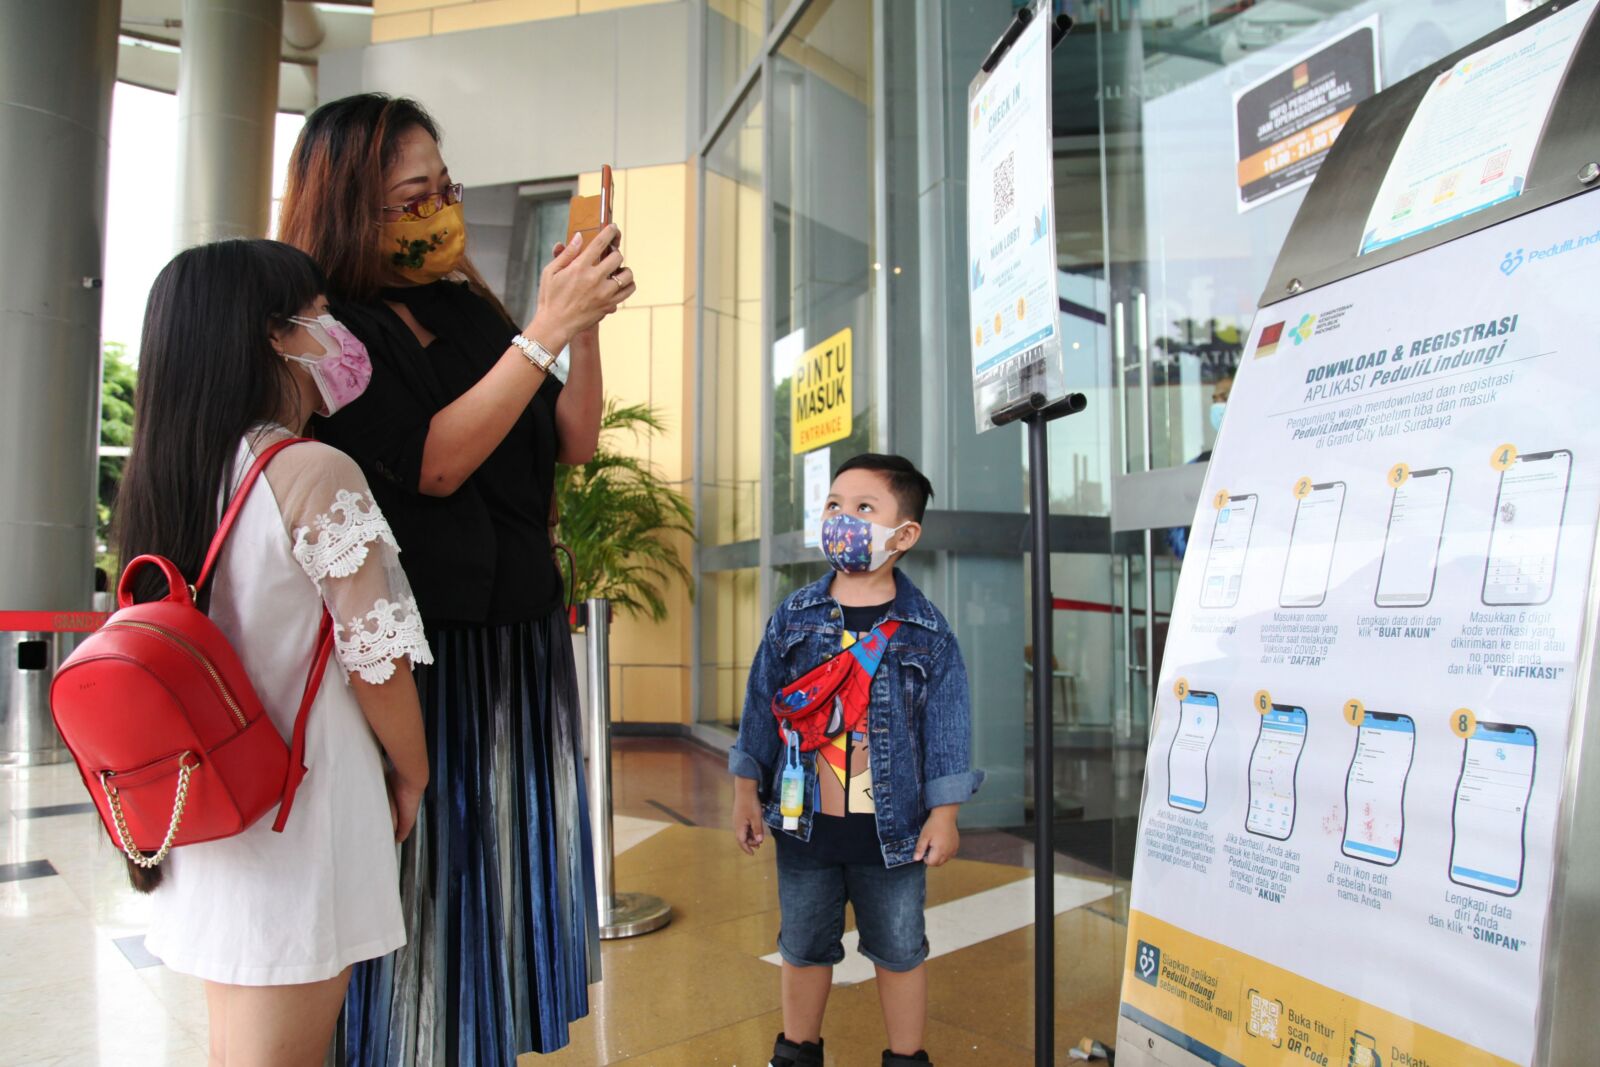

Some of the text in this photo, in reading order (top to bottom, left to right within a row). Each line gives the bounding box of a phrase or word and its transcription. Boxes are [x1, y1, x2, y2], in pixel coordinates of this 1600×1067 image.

[988, 82, 1021, 133] CHECK IN
[1528, 231, 1600, 263] PeduliLind
[1306, 314, 1519, 384] DOWNLOAD & REGISTRASI
[797, 342, 846, 393] PINTU
[1304, 340, 1508, 403] APLIKASI PeduliLindungi
[796, 376, 846, 423] MASUK
[1286, 370, 1515, 430] Pengunjung wajib mendownload dan registrasi
[1292, 391, 1498, 441] PeduliLindungi sebelum tiba dan masuk
[800, 416, 842, 445] ENTRANCE
[1315, 414, 1452, 449] di Grand City Mall Surabaya
[1498, 449, 1509, 465] 4
[1394, 467, 1403, 483] 3
[1299, 481, 1307, 494] 2
[1218, 494, 1224, 505] 1
[1357, 616, 1441, 627] Lengkapi data diri dan
[1470, 611, 1551, 625] Masukkan 6 digit
[1322, 625, 1338, 636] yang
[1358, 627, 1372, 638] klik
[1461, 625, 1556, 639] kode verifikasi yang
[1294, 645, 1328, 656] COVID-19
[1451, 637, 1566, 652] dikirimkan ke email atau
[1447, 664, 1464, 675] dan
[1466, 664, 1483, 676] klik
[1469, 652, 1541, 666] no ponsel anda
[1178, 682, 1185, 695] 5
[1259, 695, 1266, 709] 6
[1350, 704, 1358, 721] 7
[1458, 714, 1468, 732] 8
[1223, 844, 1300, 874] masuk ke halaman utama
[1266, 843, 1283, 857] Anda
[1284, 848, 1301, 861] akan
[1228, 855, 1292, 883] PeduliLindungi dan
[1334, 860, 1388, 886] Pilih ikon edit
[1228, 880, 1235, 889] di
[1236, 882, 1252, 896] menu
[1230, 867, 1287, 895] lengkapi data anda
[1326, 872, 1392, 900] di sebelah kanan
[1337, 888, 1381, 910] nama Anda
[1445, 890, 1513, 920] Lengkapi data
[1428, 914, 1444, 928] dan
[1447, 919, 1464, 935] klik
[1454, 907, 1499, 931] diri Anda
[1163, 953, 1218, 988] Siapkan aplikasi
[1161, 966, 1216, 1000] PeduliLindungi
[1159, 980, 1233, 1022] sebelum masuk mall
[1287, 1025, 1309, 1042] scan
[1288, 1008, 1335, 1040] Buka fitur
[1287, 1038, 1328, 1067] QR Code
